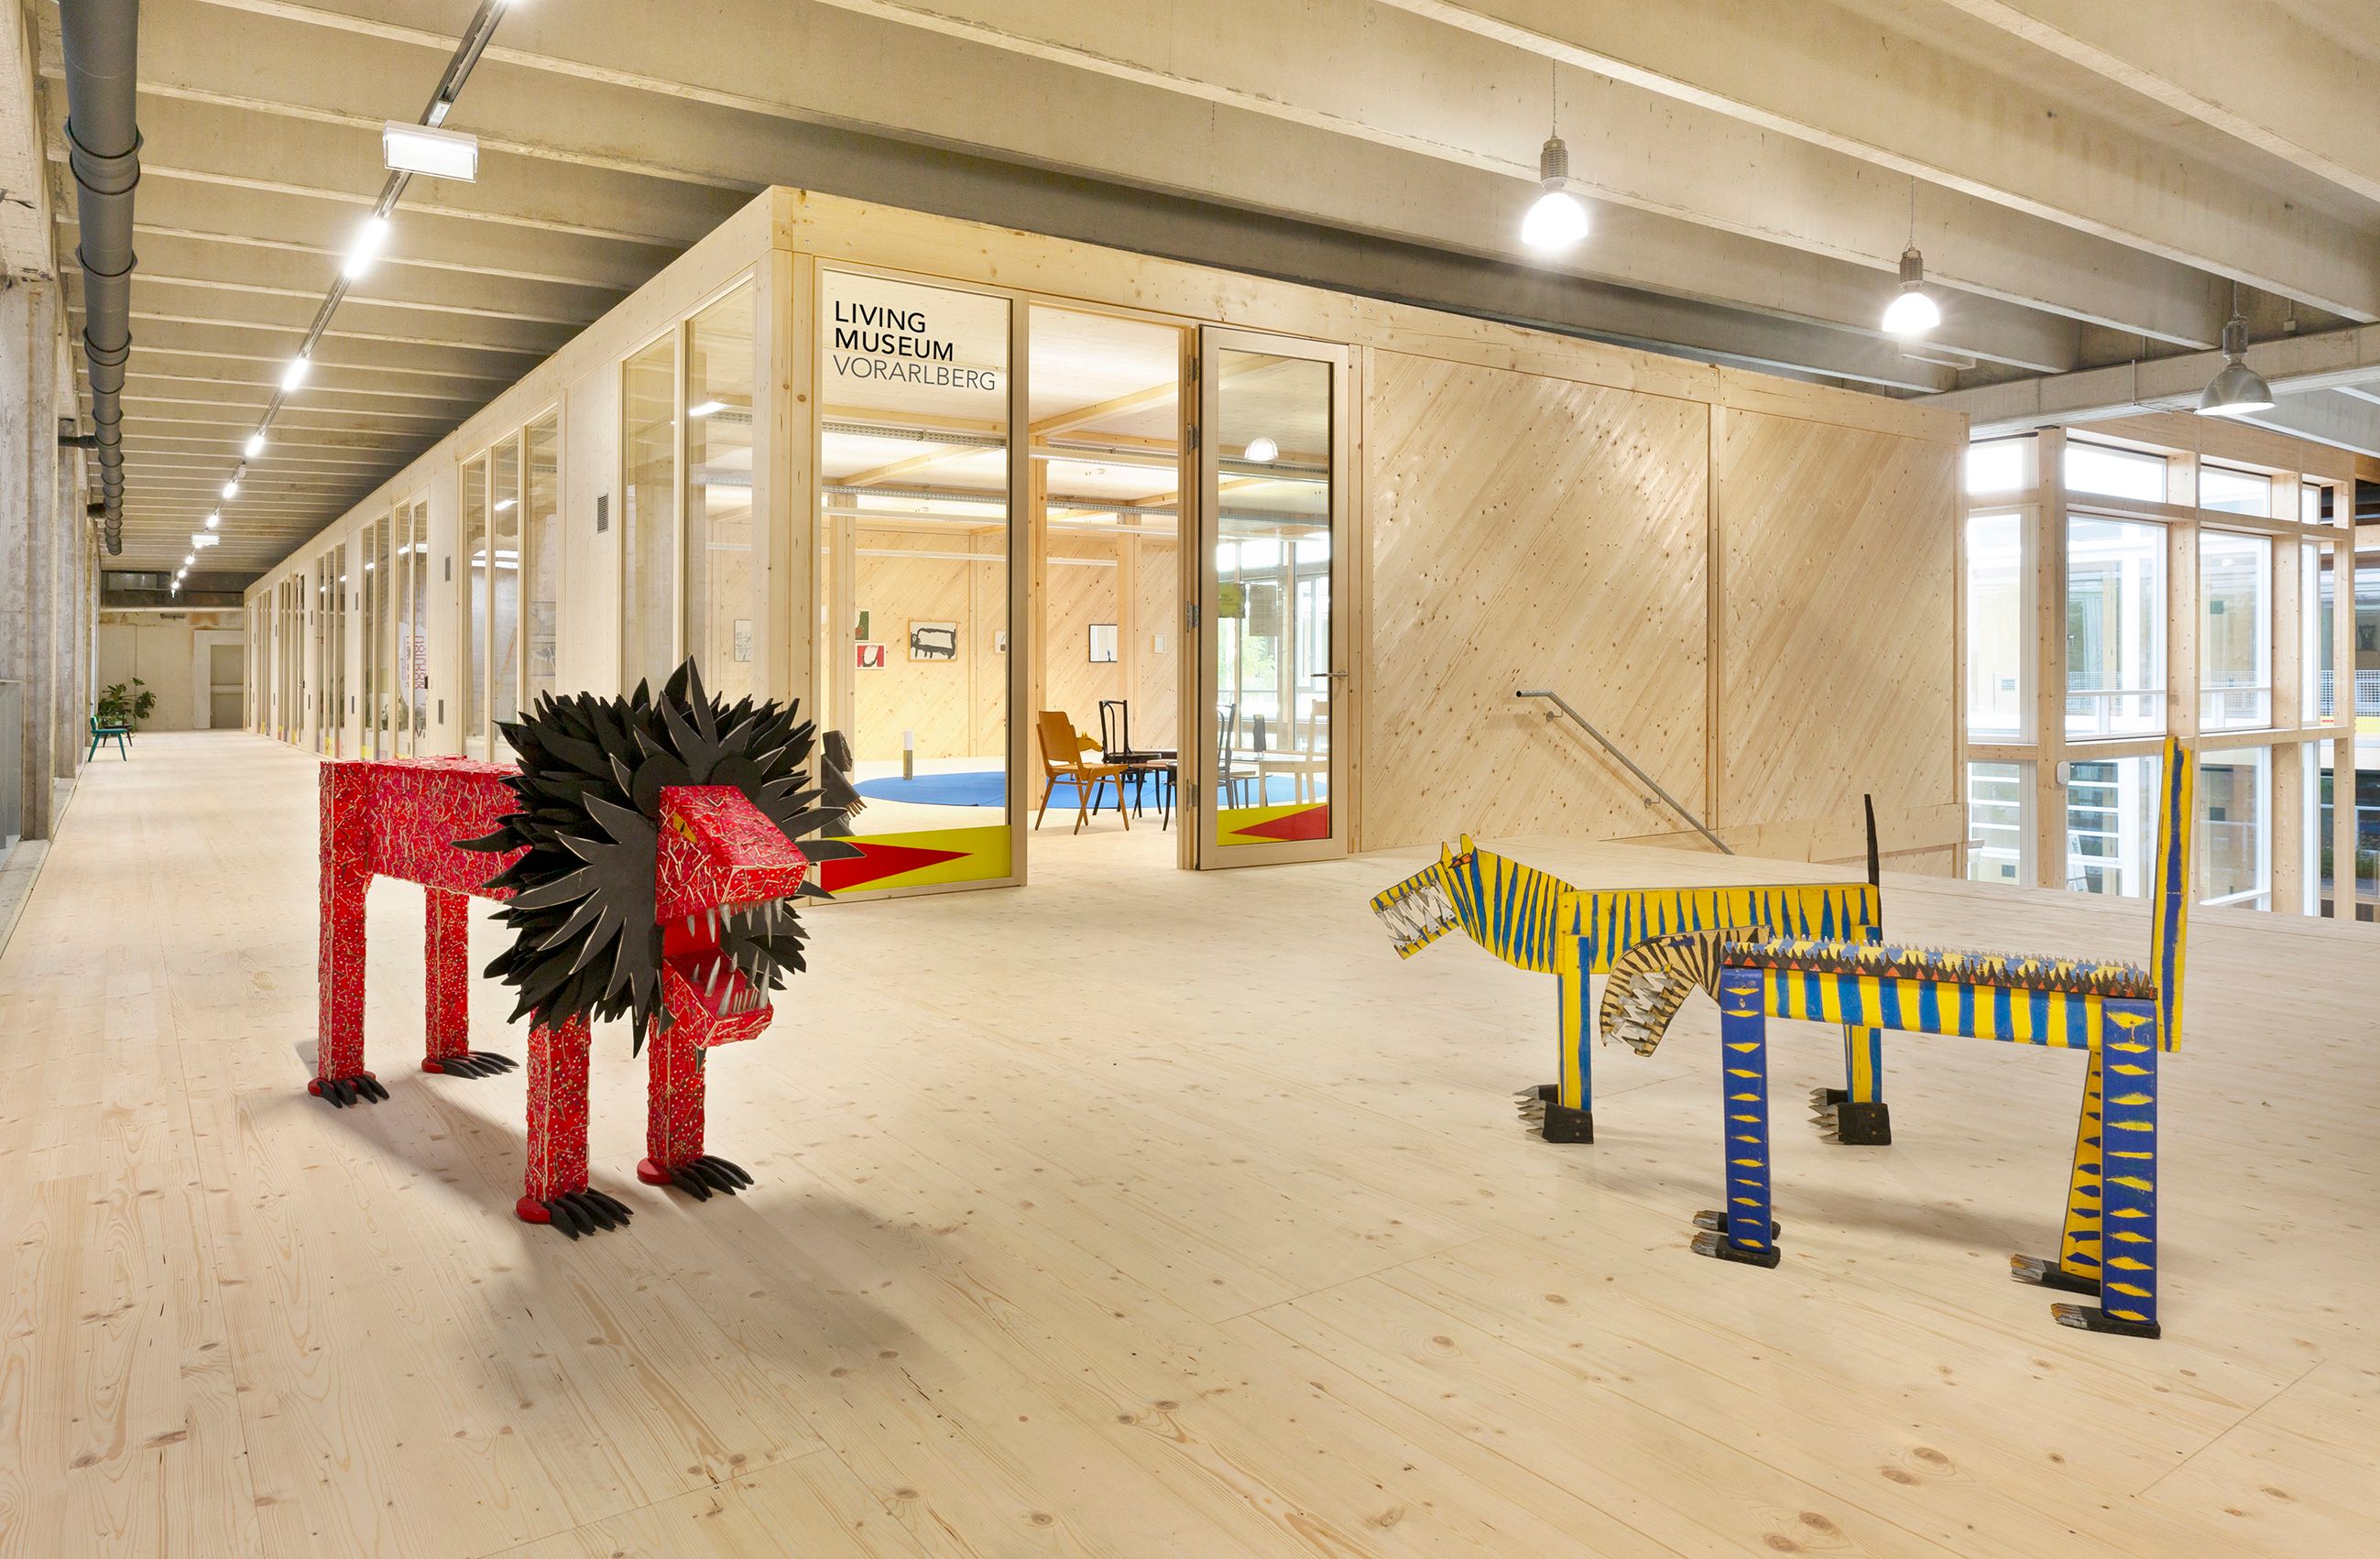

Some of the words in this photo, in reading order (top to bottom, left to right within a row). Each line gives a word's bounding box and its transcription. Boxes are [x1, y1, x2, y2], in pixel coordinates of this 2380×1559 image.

[835, 300, 925, 333] LIVING
[835, 328, 954, 361] MUSEUM
[834, 354, 996, 390] VORARLBERG
